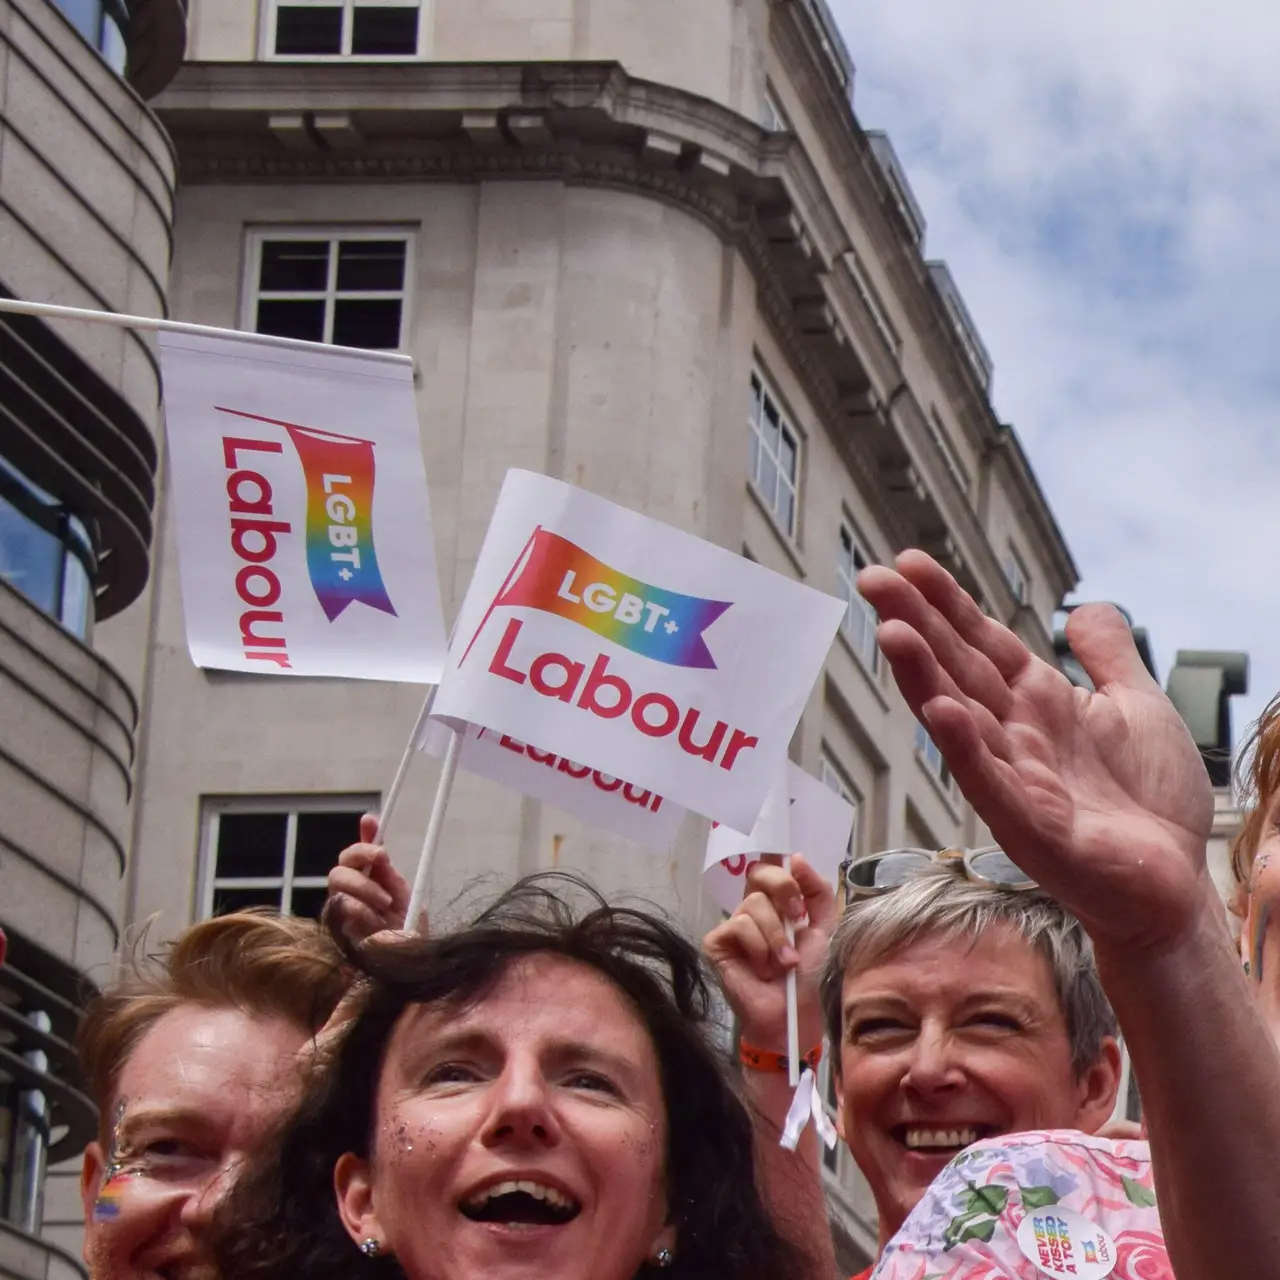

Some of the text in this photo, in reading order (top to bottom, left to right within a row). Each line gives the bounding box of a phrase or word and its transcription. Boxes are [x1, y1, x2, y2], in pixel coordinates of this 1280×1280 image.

[221, 435, 292, 669] Labour
[319, 473, 361, 582] LGBT+
[556, 569, 679, 637] LGBT+
[487, 619, 759, 772] Labour
[1033, 1217, 1052, 1268] NEVER
[1045, 1216, 1065, 1272] KISSED
[1057, 1217, 1077, 1274] A TORY
